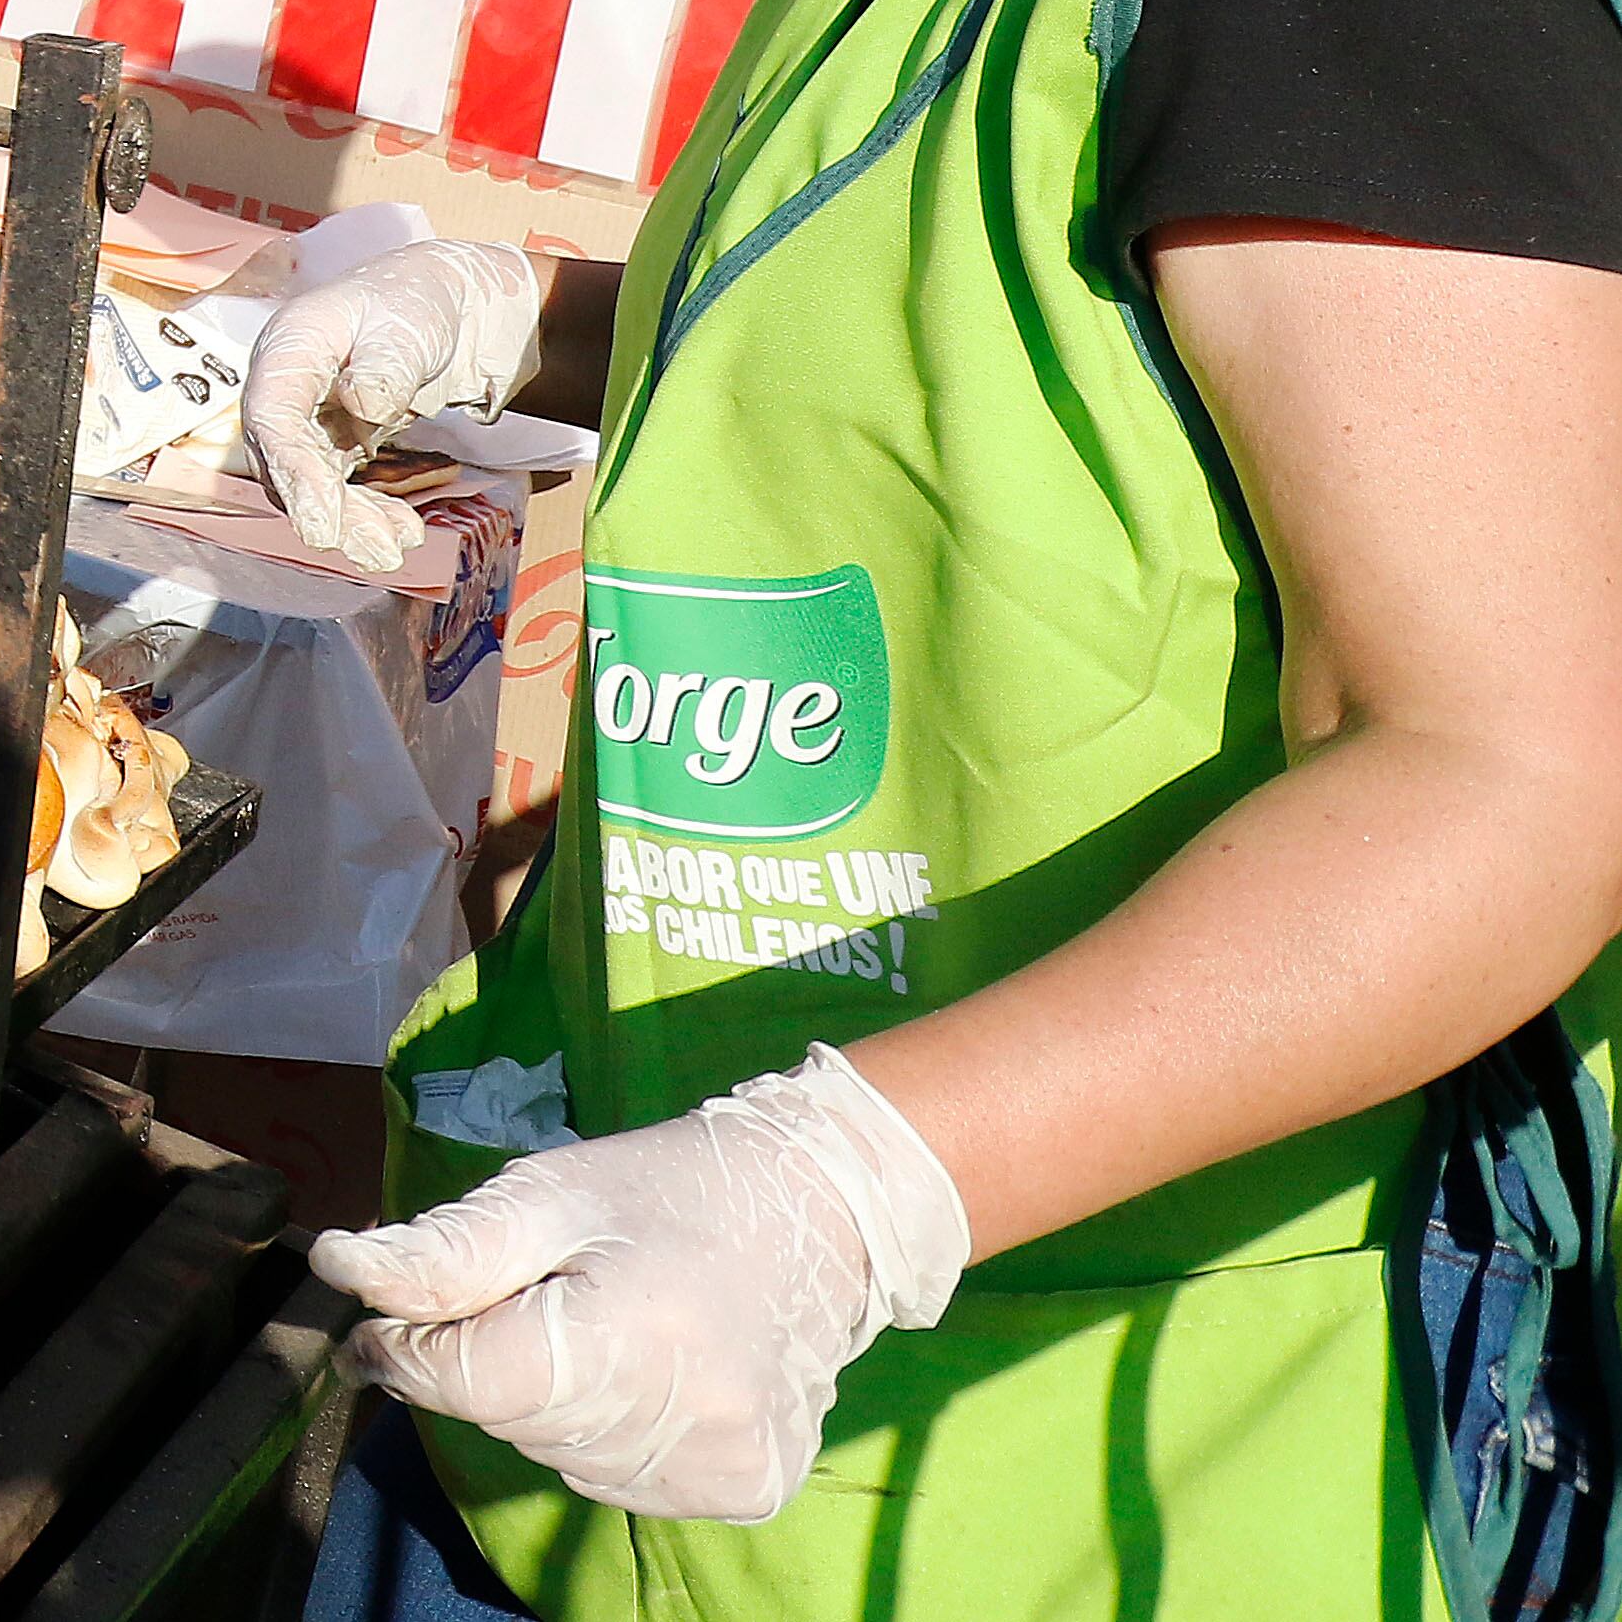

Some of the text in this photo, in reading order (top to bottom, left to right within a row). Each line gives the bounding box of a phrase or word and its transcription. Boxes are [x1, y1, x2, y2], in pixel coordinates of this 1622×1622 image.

[603, 836, 938, 920] ABOR QUE UNE
[656, 903, 909, 995] CHILENOS!
